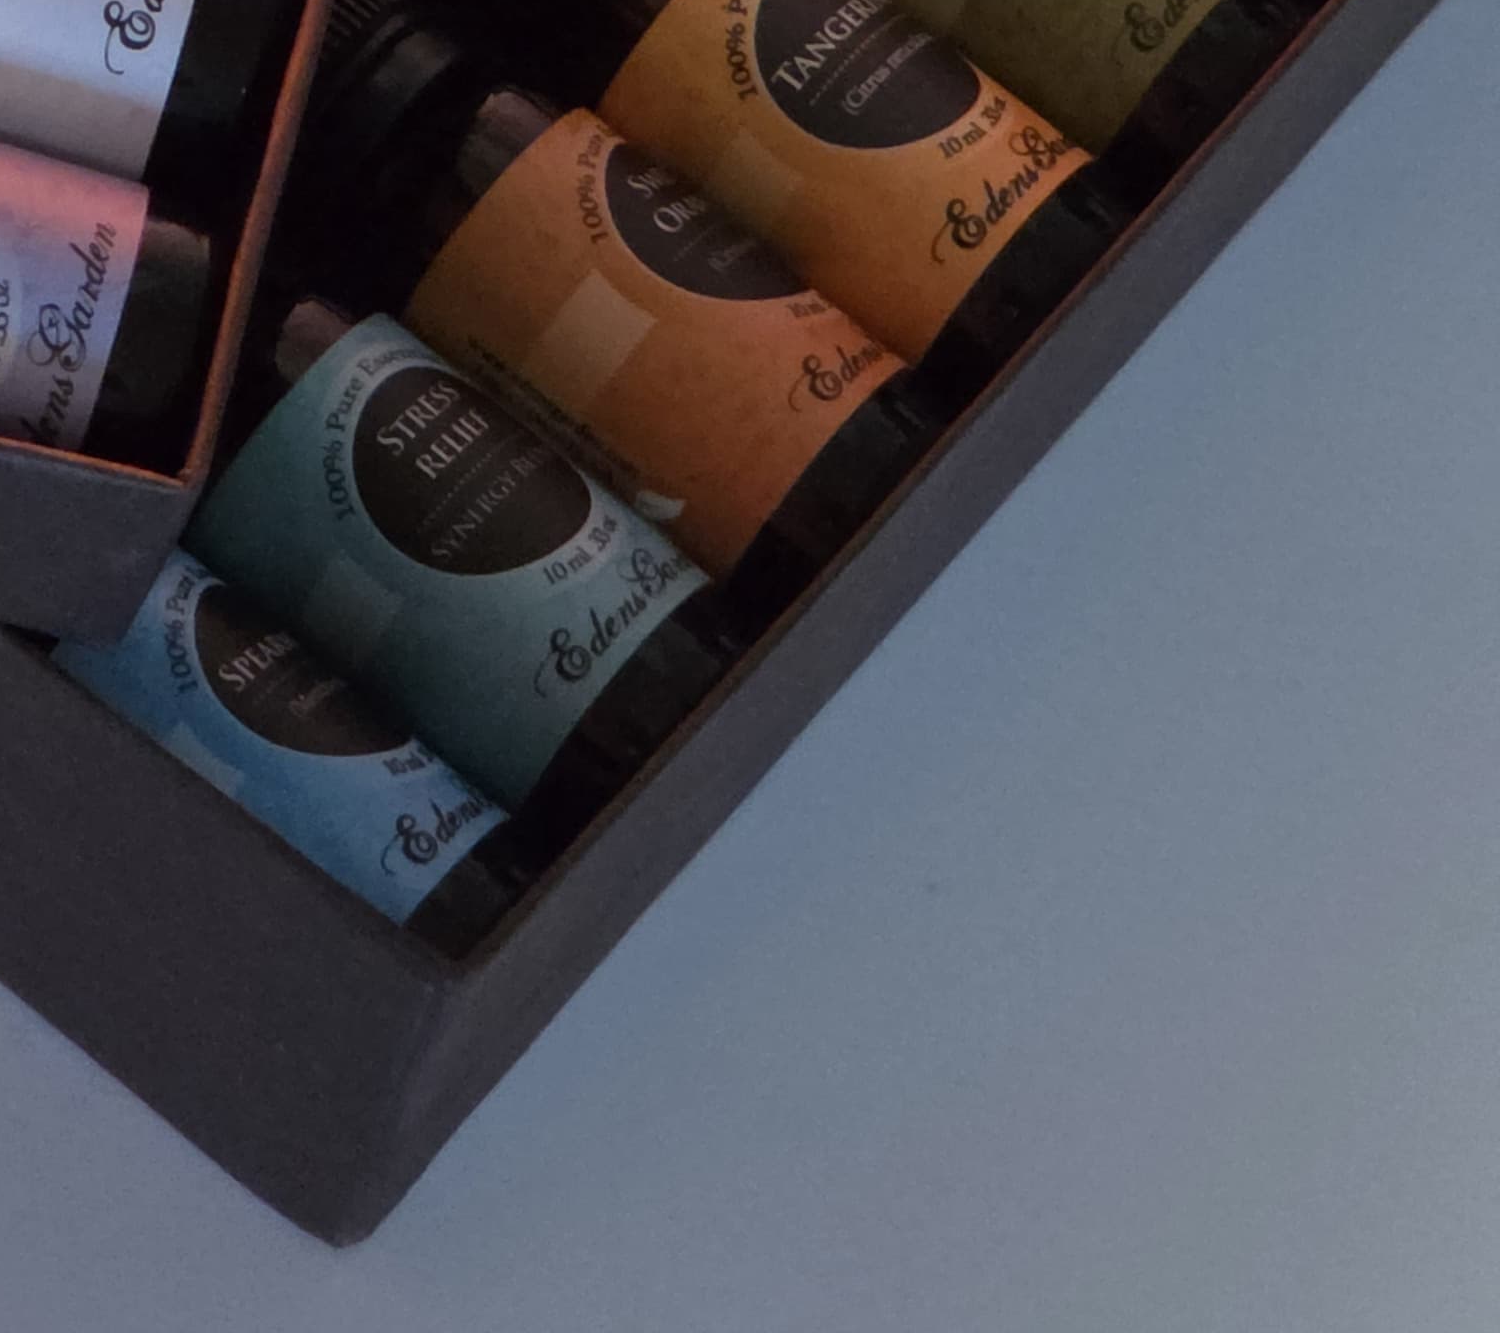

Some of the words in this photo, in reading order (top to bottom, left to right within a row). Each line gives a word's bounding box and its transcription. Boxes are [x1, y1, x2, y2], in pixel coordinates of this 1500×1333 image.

[725, 21, 760, 101] 100%
[929, 163, 1040, 266] Edens
[25, 220, 117, 372] Garden
[323, 380, 366, 436] Pure
[375, 376, 462, 458] STRESS
[412, 407, 491, 482] RELIEF
[533, 583, 650, 698] Edens
